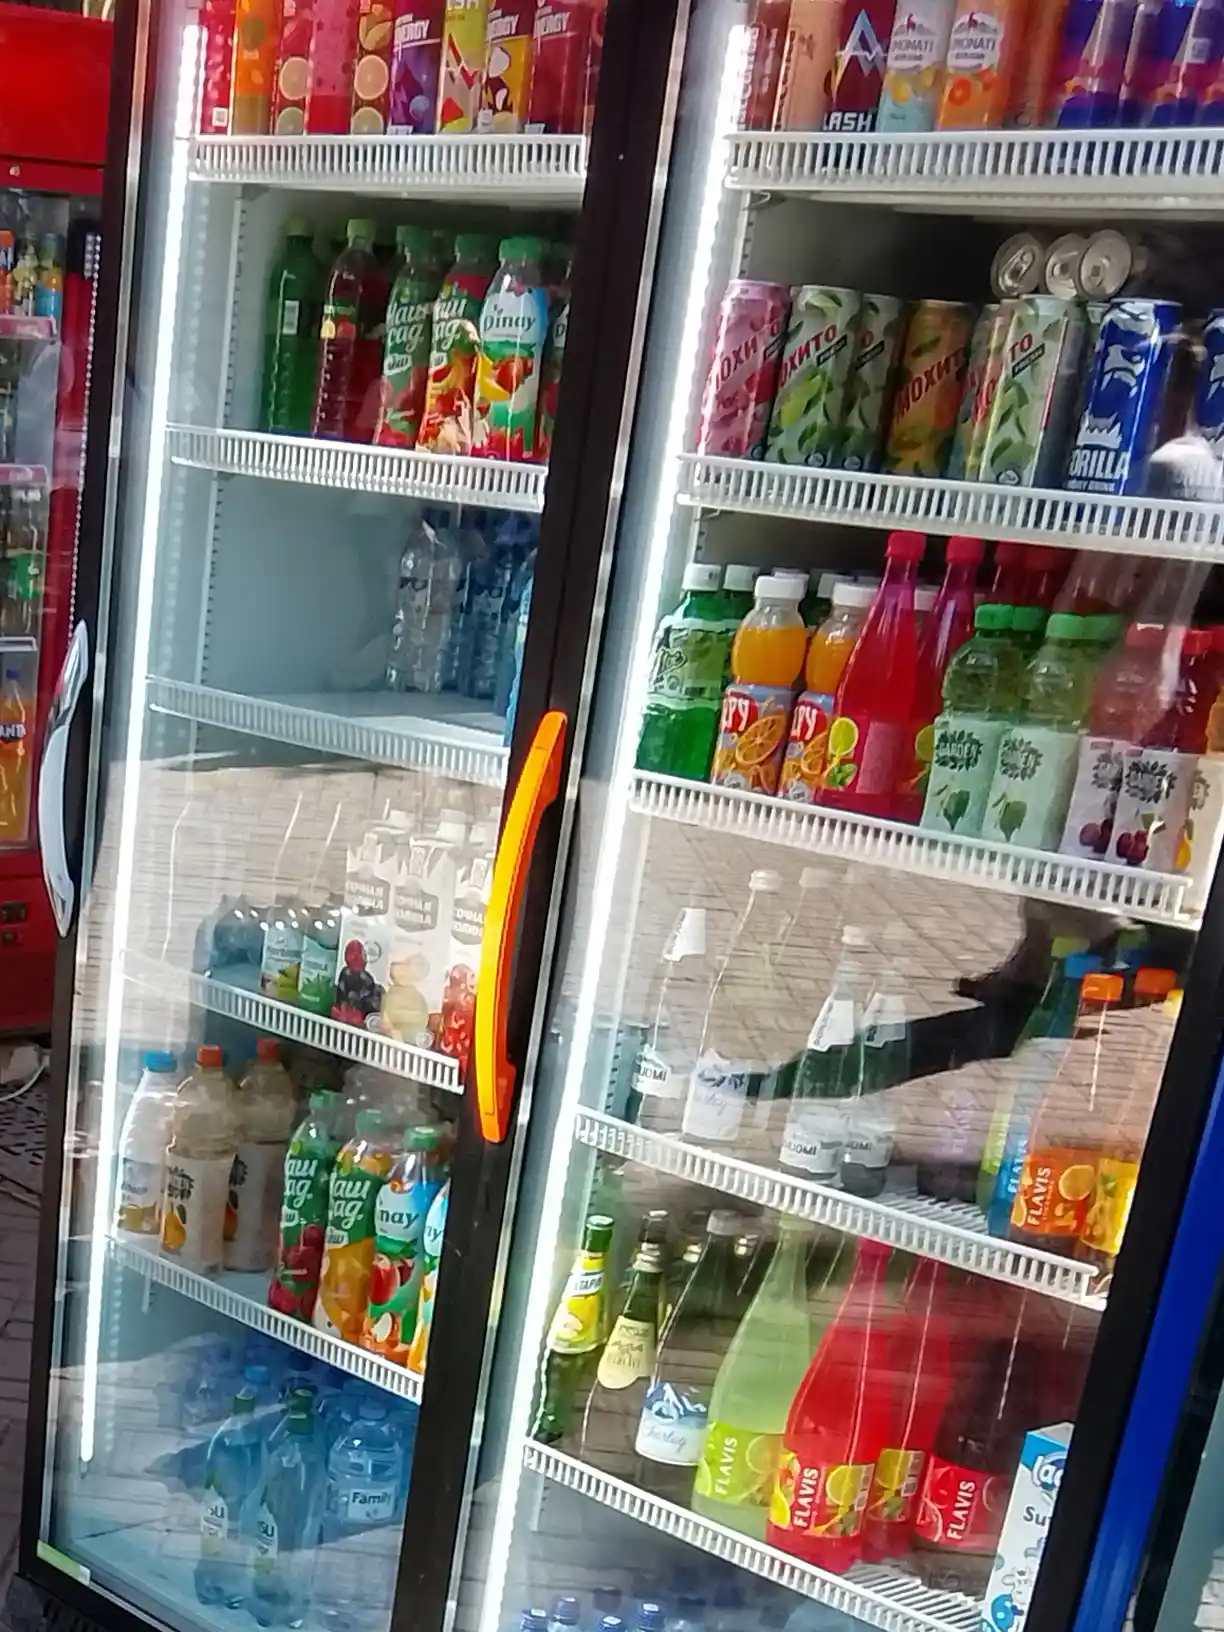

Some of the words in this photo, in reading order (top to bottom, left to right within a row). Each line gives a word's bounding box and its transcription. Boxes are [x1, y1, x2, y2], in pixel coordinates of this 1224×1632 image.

[1069, 448, 1130, 480] ORILLA
[378, 1207, 420, 1230] nay
[1027, 1166, 1052, 1227] FLAVIS
[715, 1437, 738, 1495] FLAVIS
[792, 1466, 819, 1528] FLAVIS
[947, 1480, 976, 1540] FLAVIS
[1023, 1505, 1051, 1527] Su
